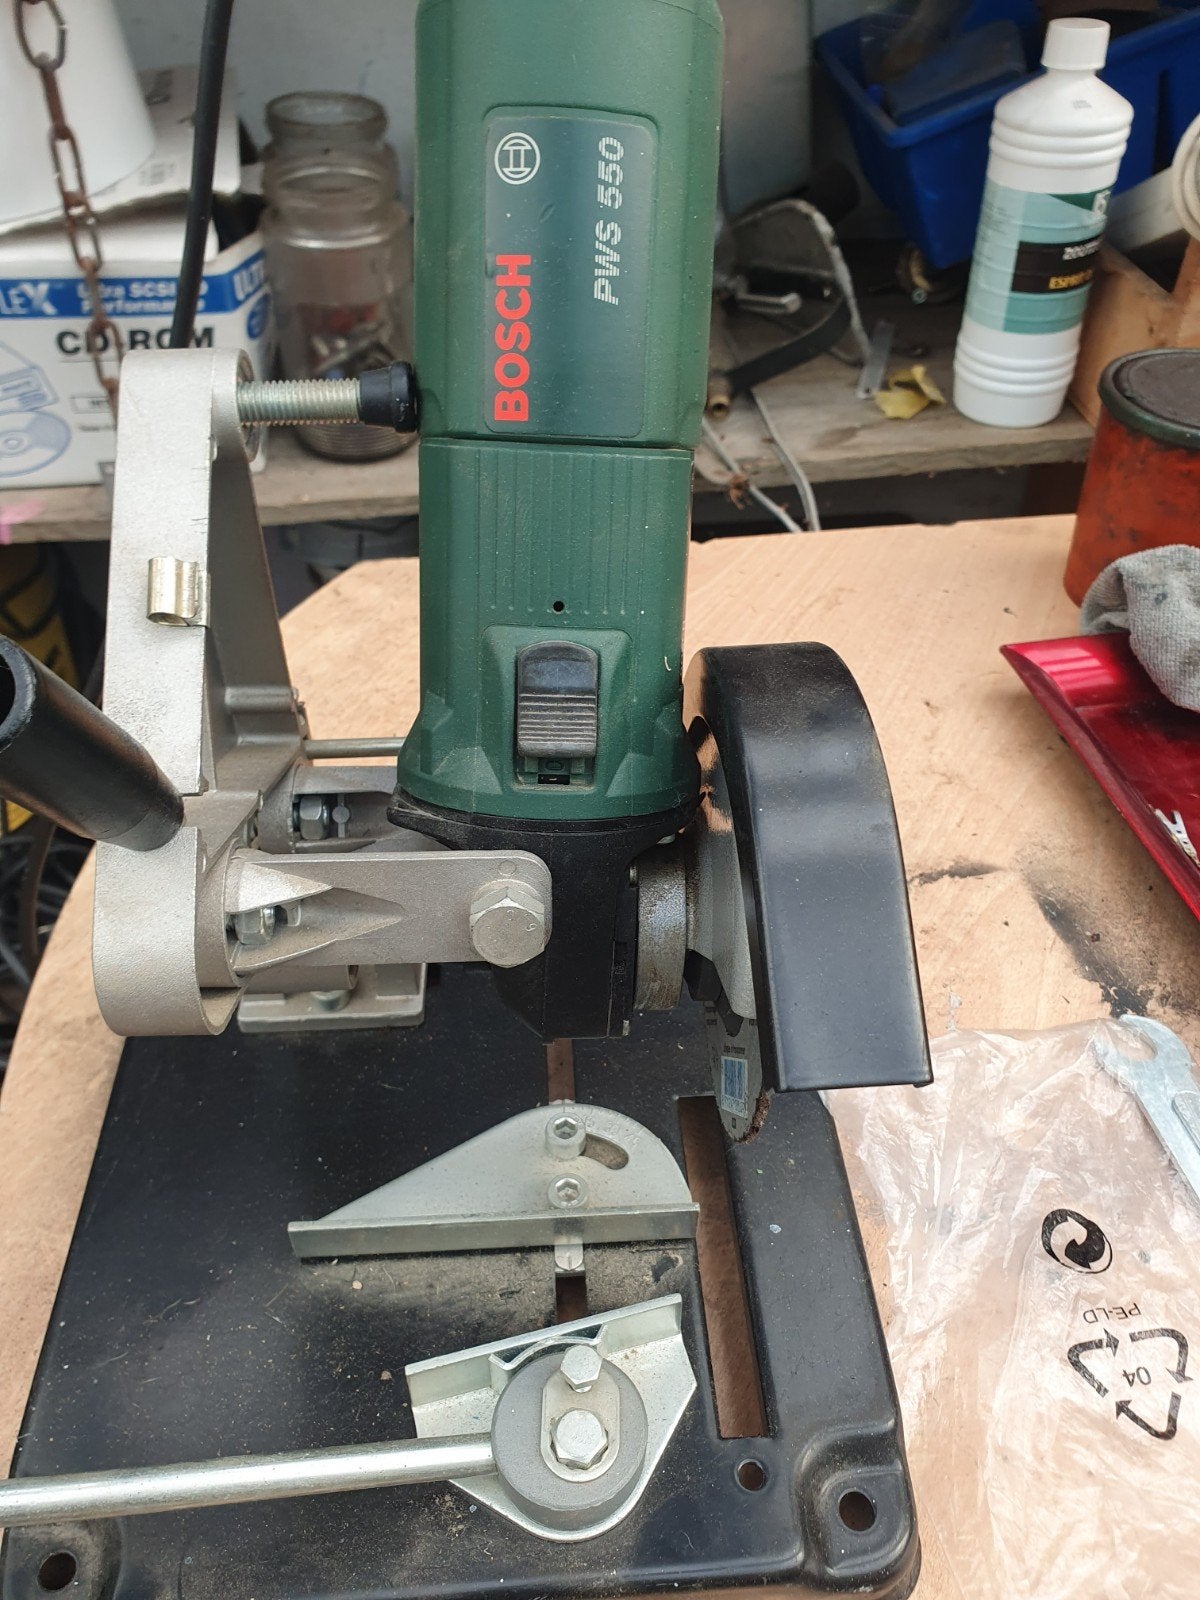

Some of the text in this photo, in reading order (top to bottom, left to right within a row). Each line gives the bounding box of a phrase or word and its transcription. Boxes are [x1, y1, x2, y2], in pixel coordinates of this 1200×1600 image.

[594, 136, 624, 305] PWS 550
[129, 281, 177, 299] SCSI
[494, 254, 532, 422] BOSCH
[1082, 1302, 1142, 1324] PE-LD
[1122, 1366, 1152, 1387] 04
